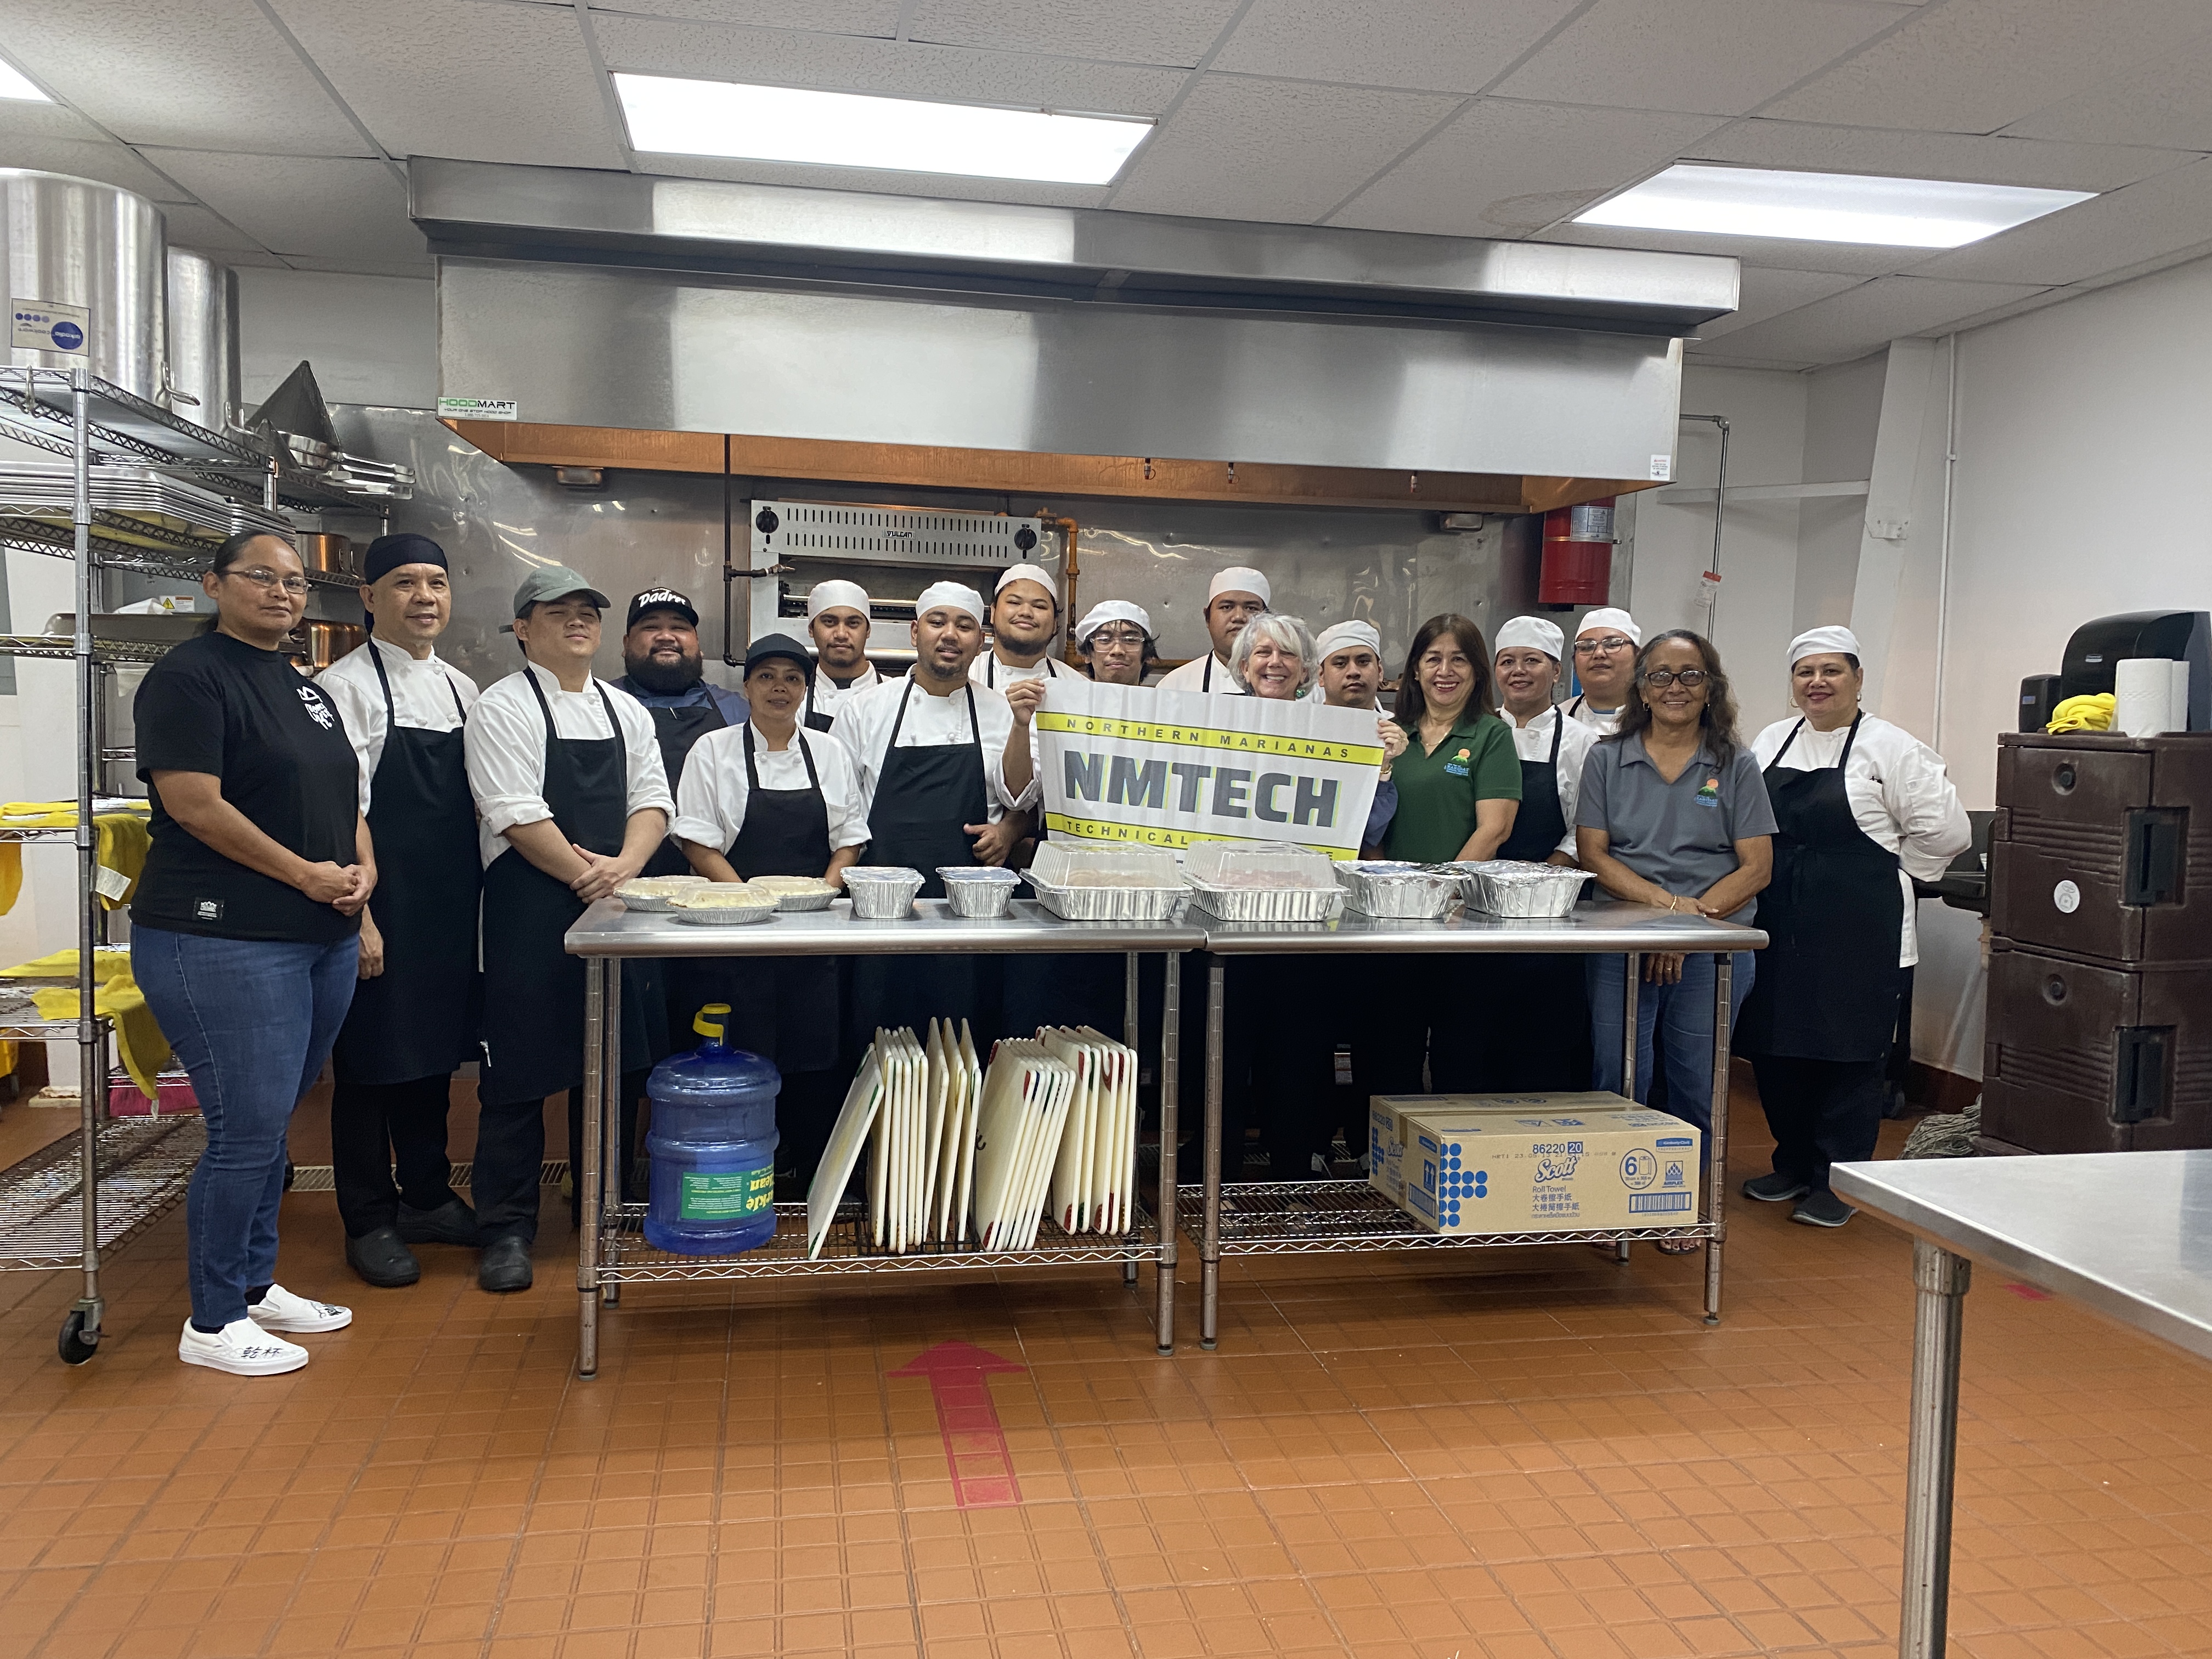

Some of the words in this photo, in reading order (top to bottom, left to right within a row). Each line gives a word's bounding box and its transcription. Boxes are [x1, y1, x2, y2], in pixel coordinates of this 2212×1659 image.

[439, 398, 515, 409] HOODMART
[1067, 719, 1199, 741] NORTHERN
[1220, 735, 1348, 758] MARIANAS
[1064, 750, 1342, 828] NMTECH
[1067, 821, 1188, 845] TECHNICAL
[1533, 1144, 1565, 1154] 86220
[1568, 1142, 1582, 1153] 20
[1534, 1155, 1578, 1183] Scott
[1625, 1156, 1637, 1176] 6
[241, 1346, 284, 1358] 乾杯
